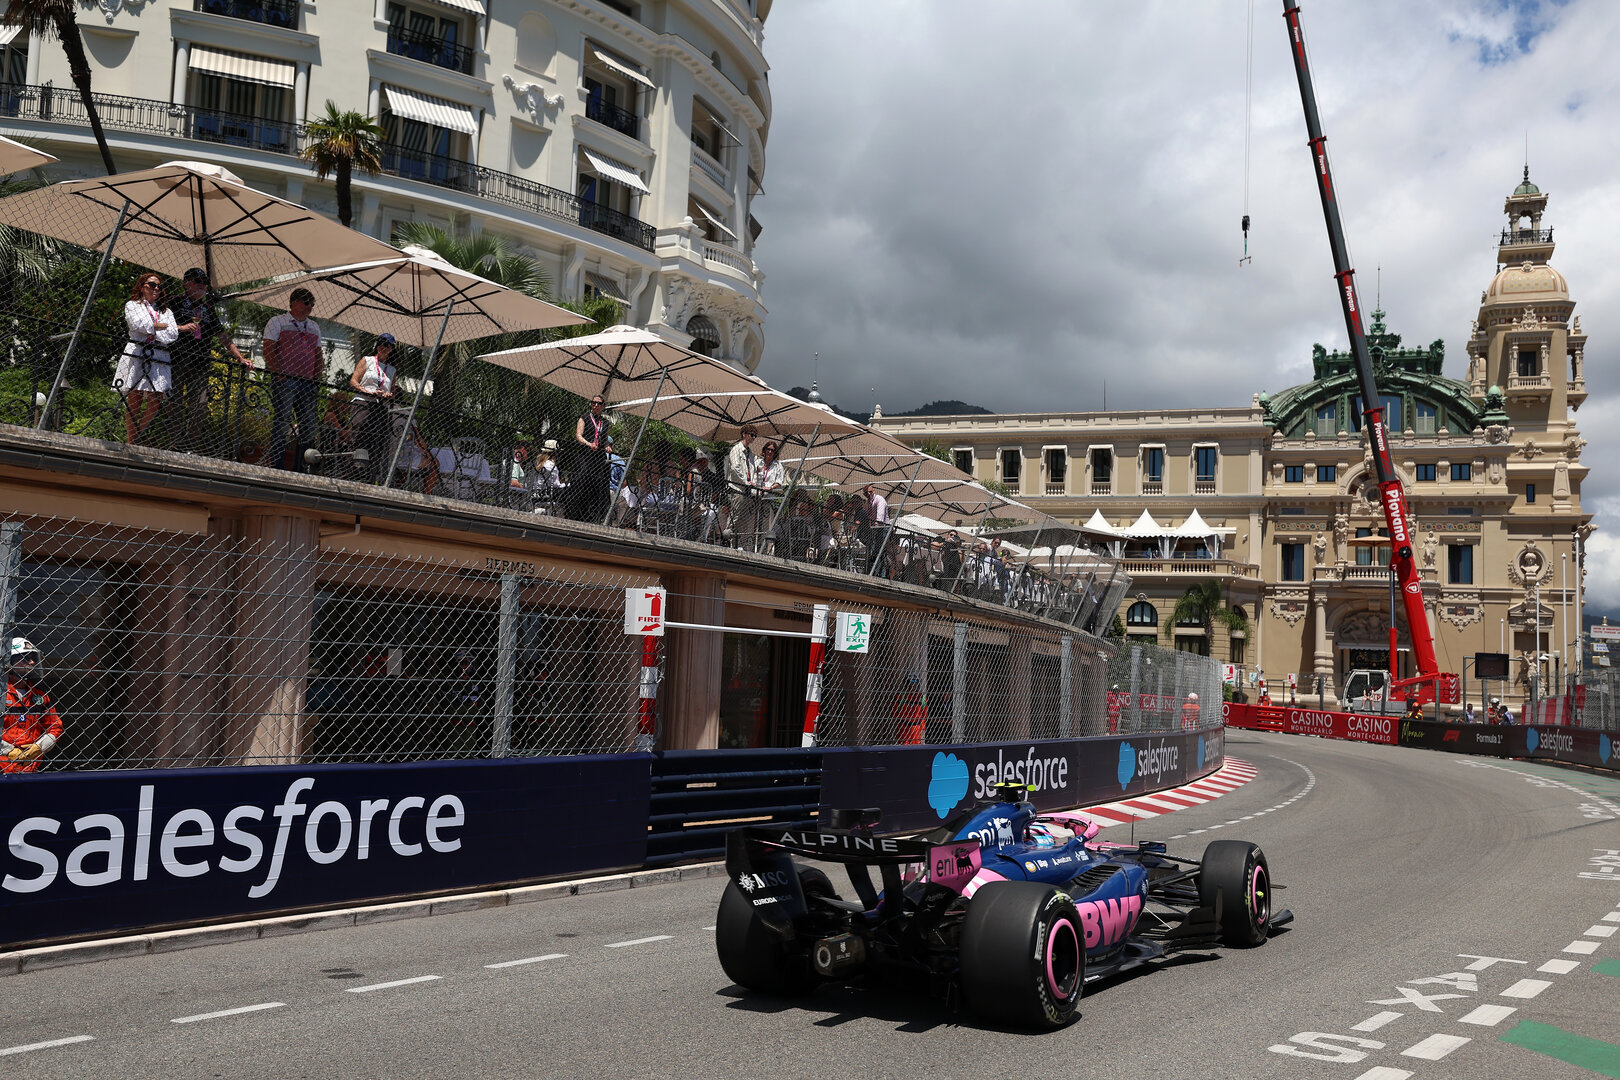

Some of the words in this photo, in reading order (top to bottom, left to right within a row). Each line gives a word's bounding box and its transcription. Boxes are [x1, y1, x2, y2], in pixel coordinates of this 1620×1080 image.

[1345, 285, 1355, 312] Piovano
[1374, 422, 1385, 452] Piovano
[1386, 489, 1406, 542] Piovano
[1291, 711, 1333, 728] CASINO
[1347, 716, 1391, 734] CASINO
[1475, 733, 1497, 744] Formula
[1540, 728, 1573, 757] salesforce
[974, 746, 1068, 802] salesforce
[1137, 737, 1179, 784] salesforce
[2, 777, 465, 898] salesforce
[779, 831, 899, 853] ALPINE
[752, 870, 789, 889] MSC
[936, 857, 955, 878] eni
[1075, 895, 1142, 949] BWT
